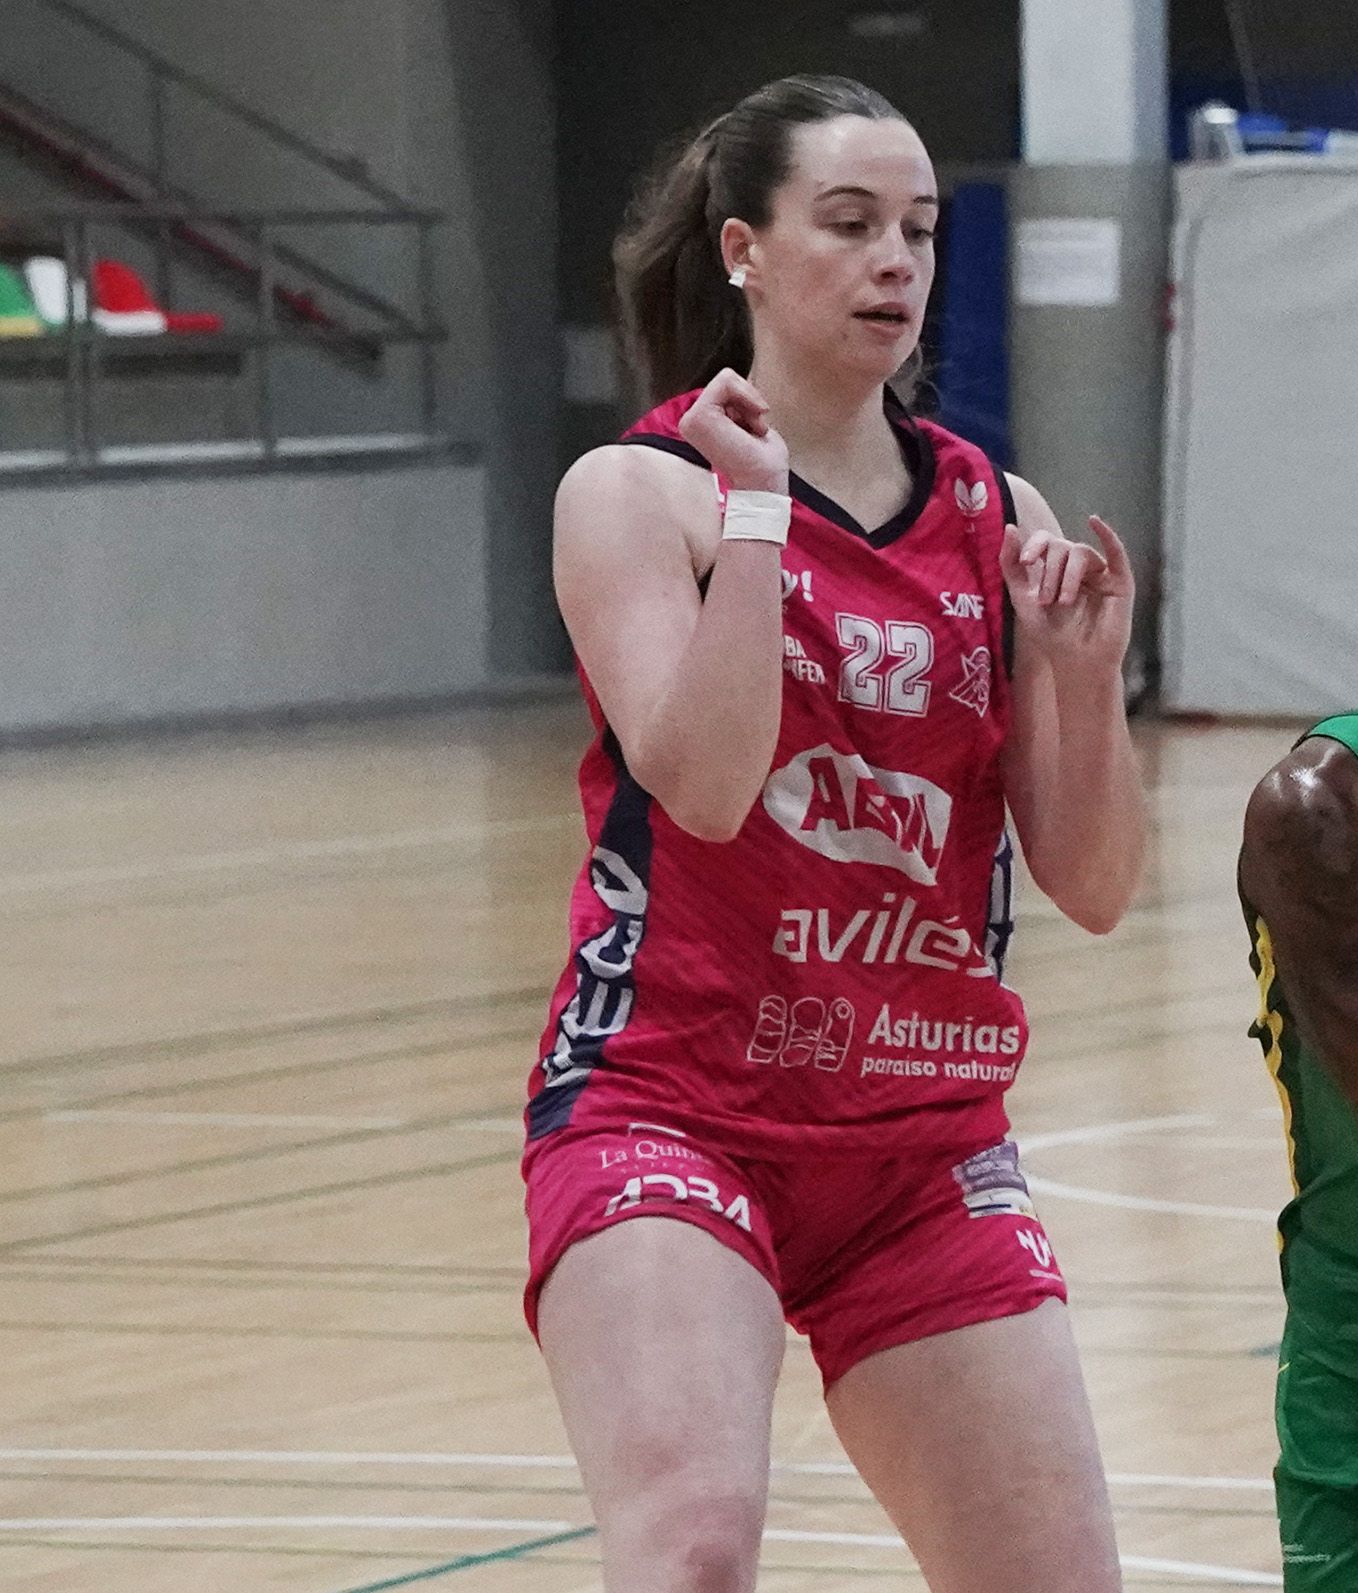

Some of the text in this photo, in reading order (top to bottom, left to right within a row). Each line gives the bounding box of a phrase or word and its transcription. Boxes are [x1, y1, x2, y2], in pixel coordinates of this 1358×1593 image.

[835, 612, 934, 717] 22
[867, 1003, 1020, 1055] Asturias
[944, 1060, 1016, 1083] natural
[600, 1149, 628, 1169] La
